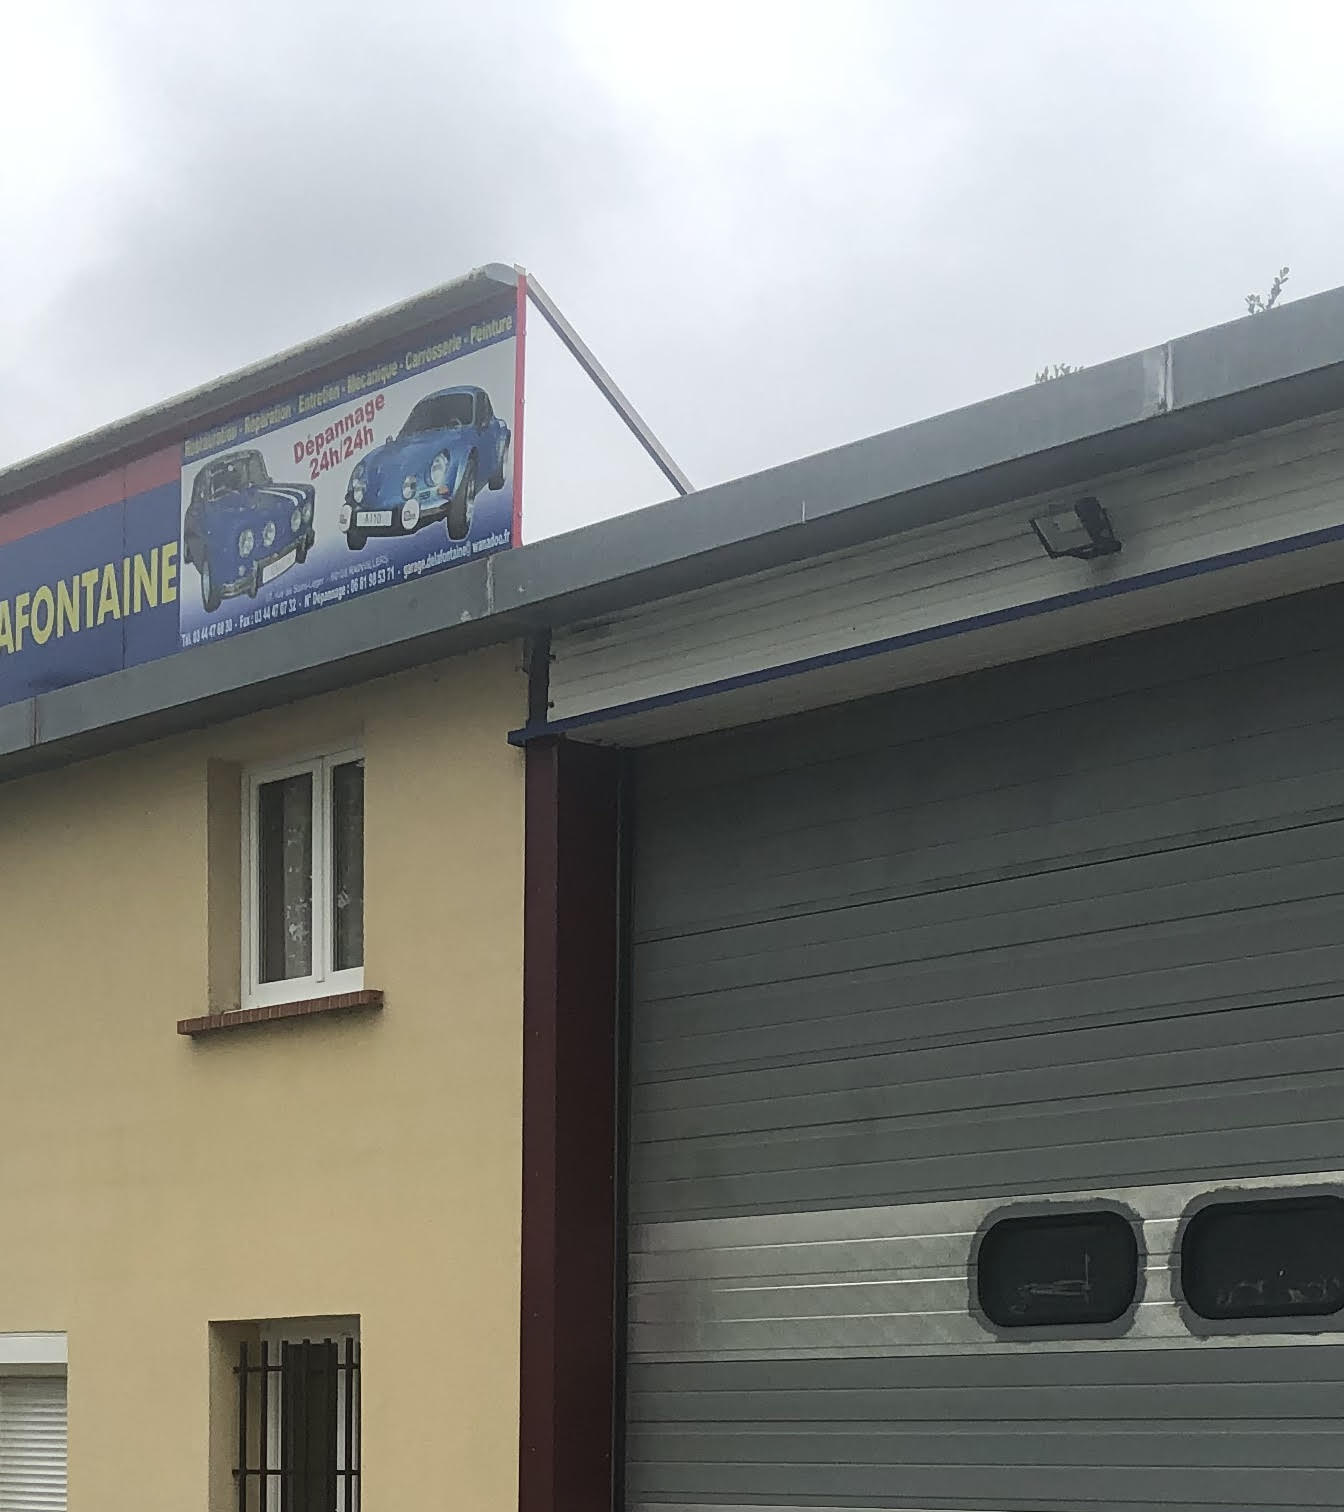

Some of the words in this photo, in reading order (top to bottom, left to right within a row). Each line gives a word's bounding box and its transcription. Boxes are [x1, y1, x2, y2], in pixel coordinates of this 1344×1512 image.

[470, 315, 513, 345] Peinture
[293, 393, 385, 465] Dépannage
[309, 426, 374, 480] 24h/24h
[263, 606, 271, 620] 44
